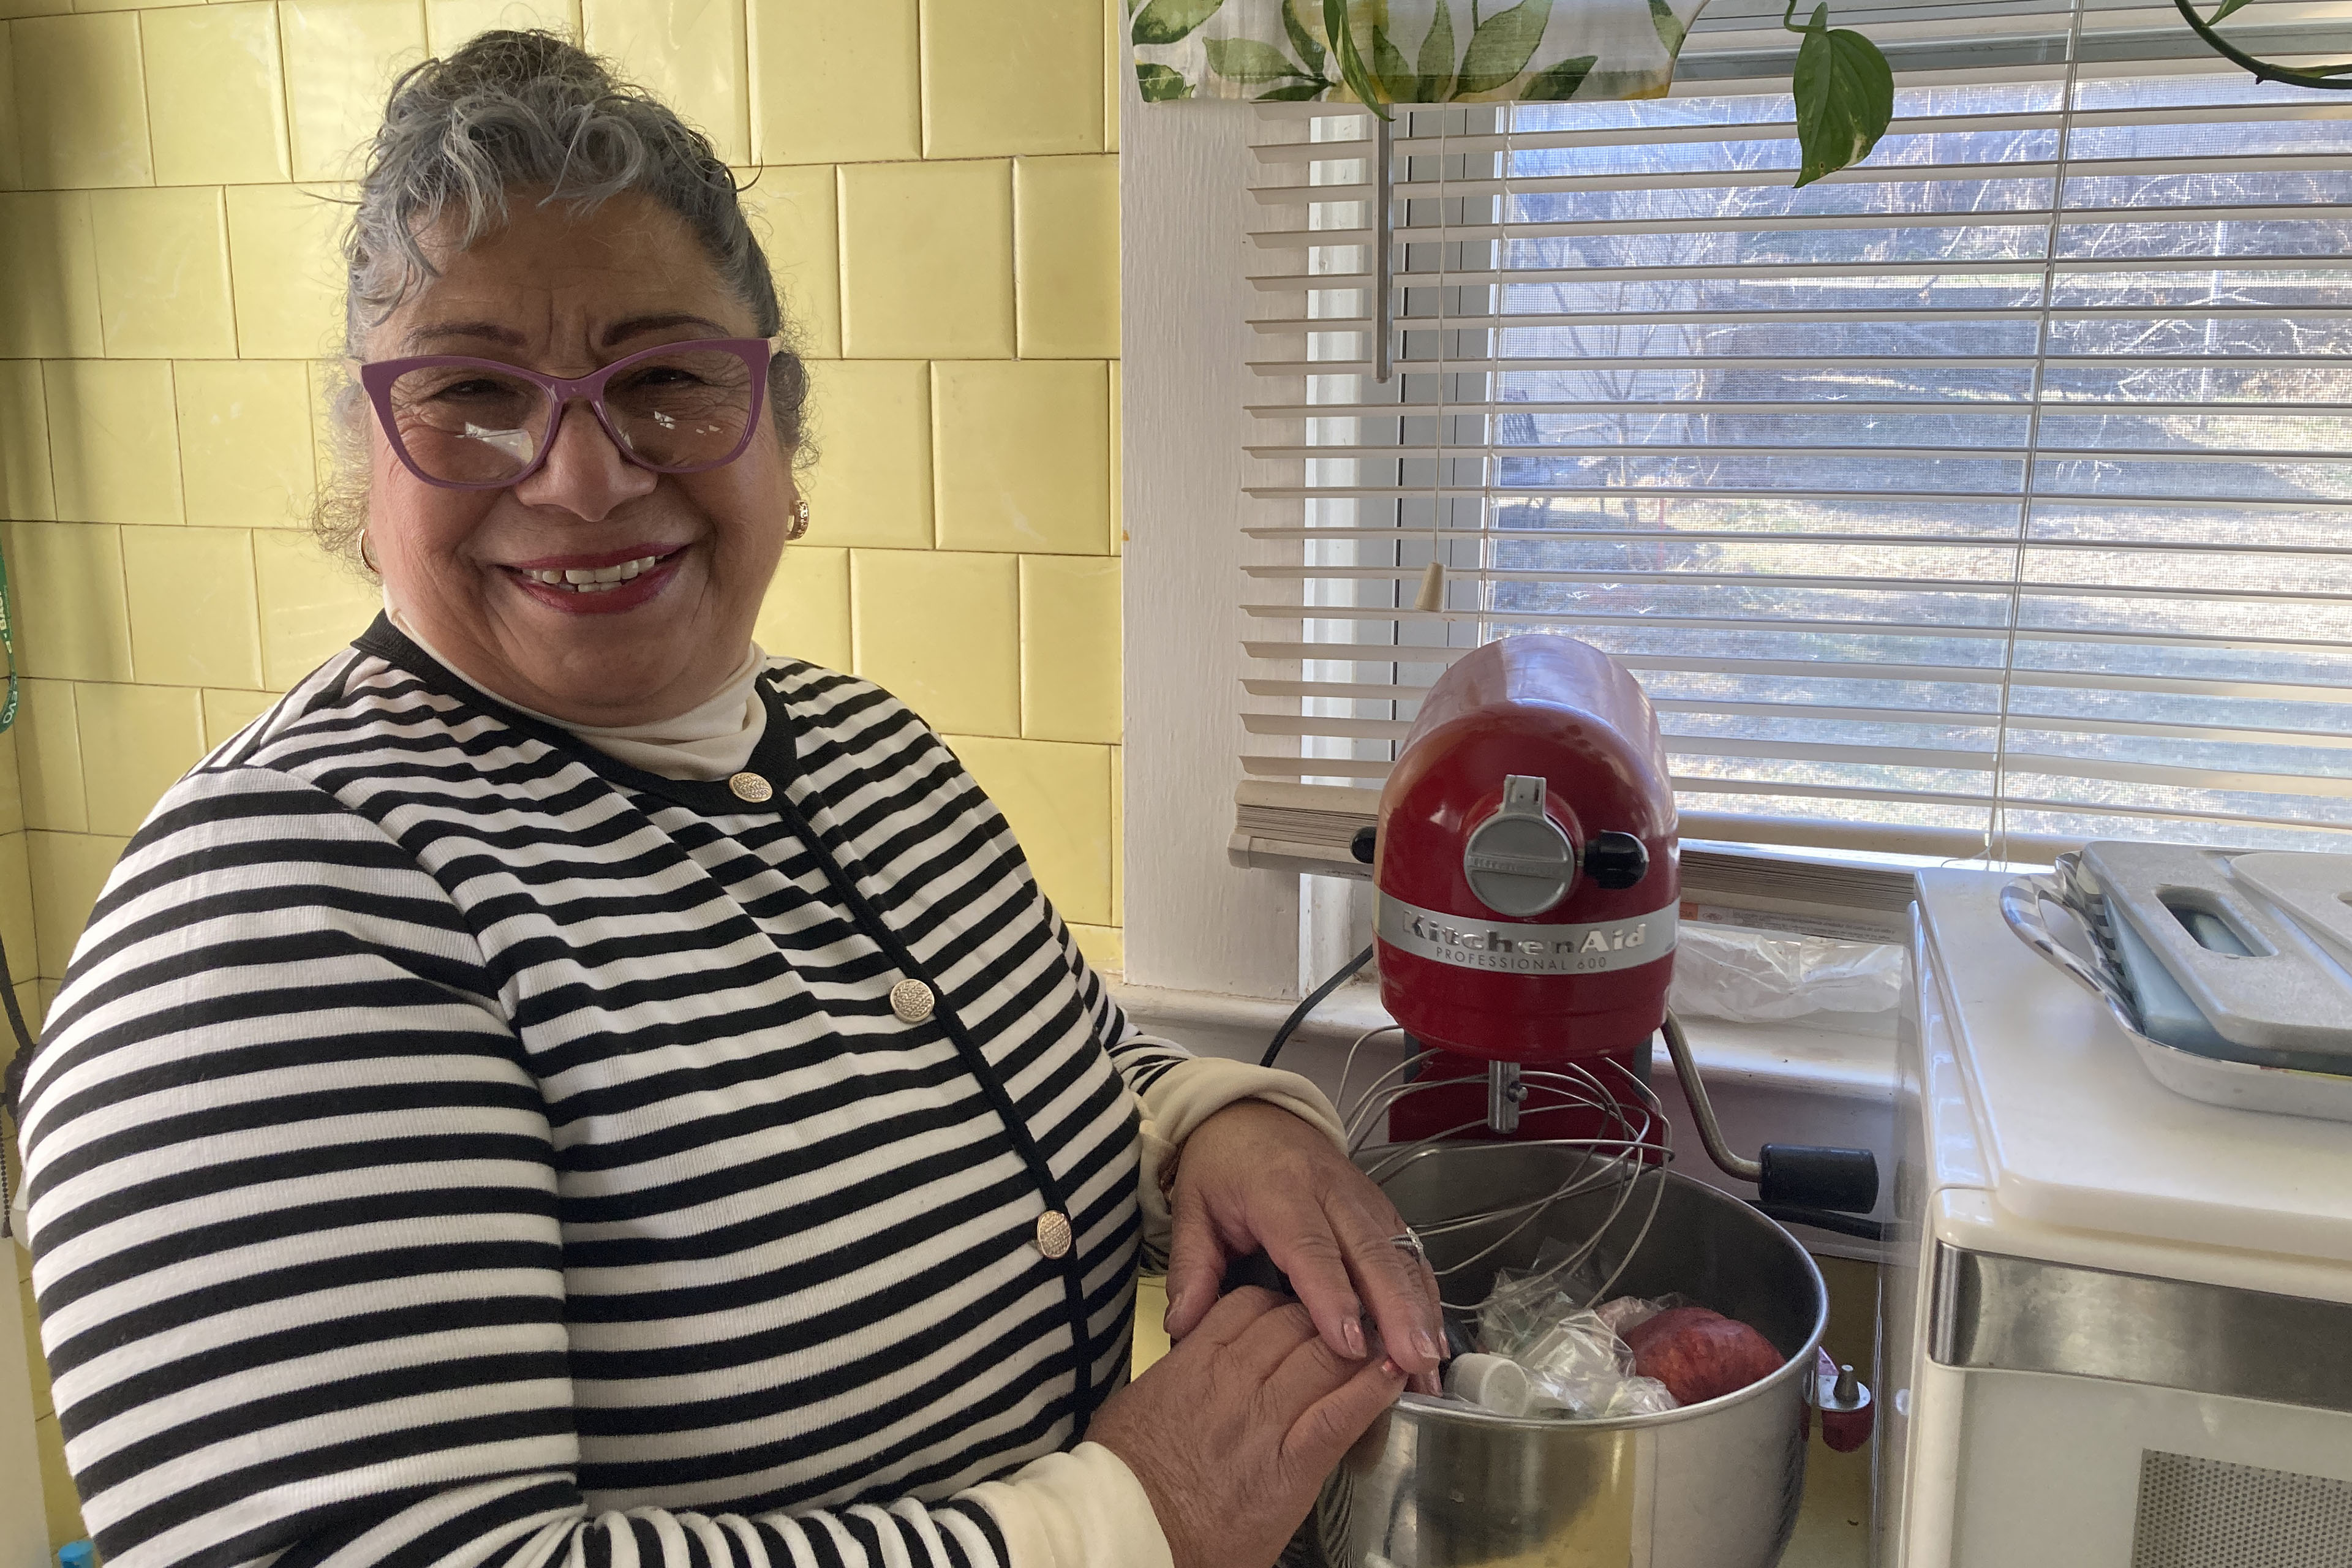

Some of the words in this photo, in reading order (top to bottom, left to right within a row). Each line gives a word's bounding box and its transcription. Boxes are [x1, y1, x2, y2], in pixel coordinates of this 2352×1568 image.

[1403, 910, 1646, 955] KitchenAid
[1436, 946, 1568, 970] PROFESSIONAL
[1577, 957, 1607, 970] 600
